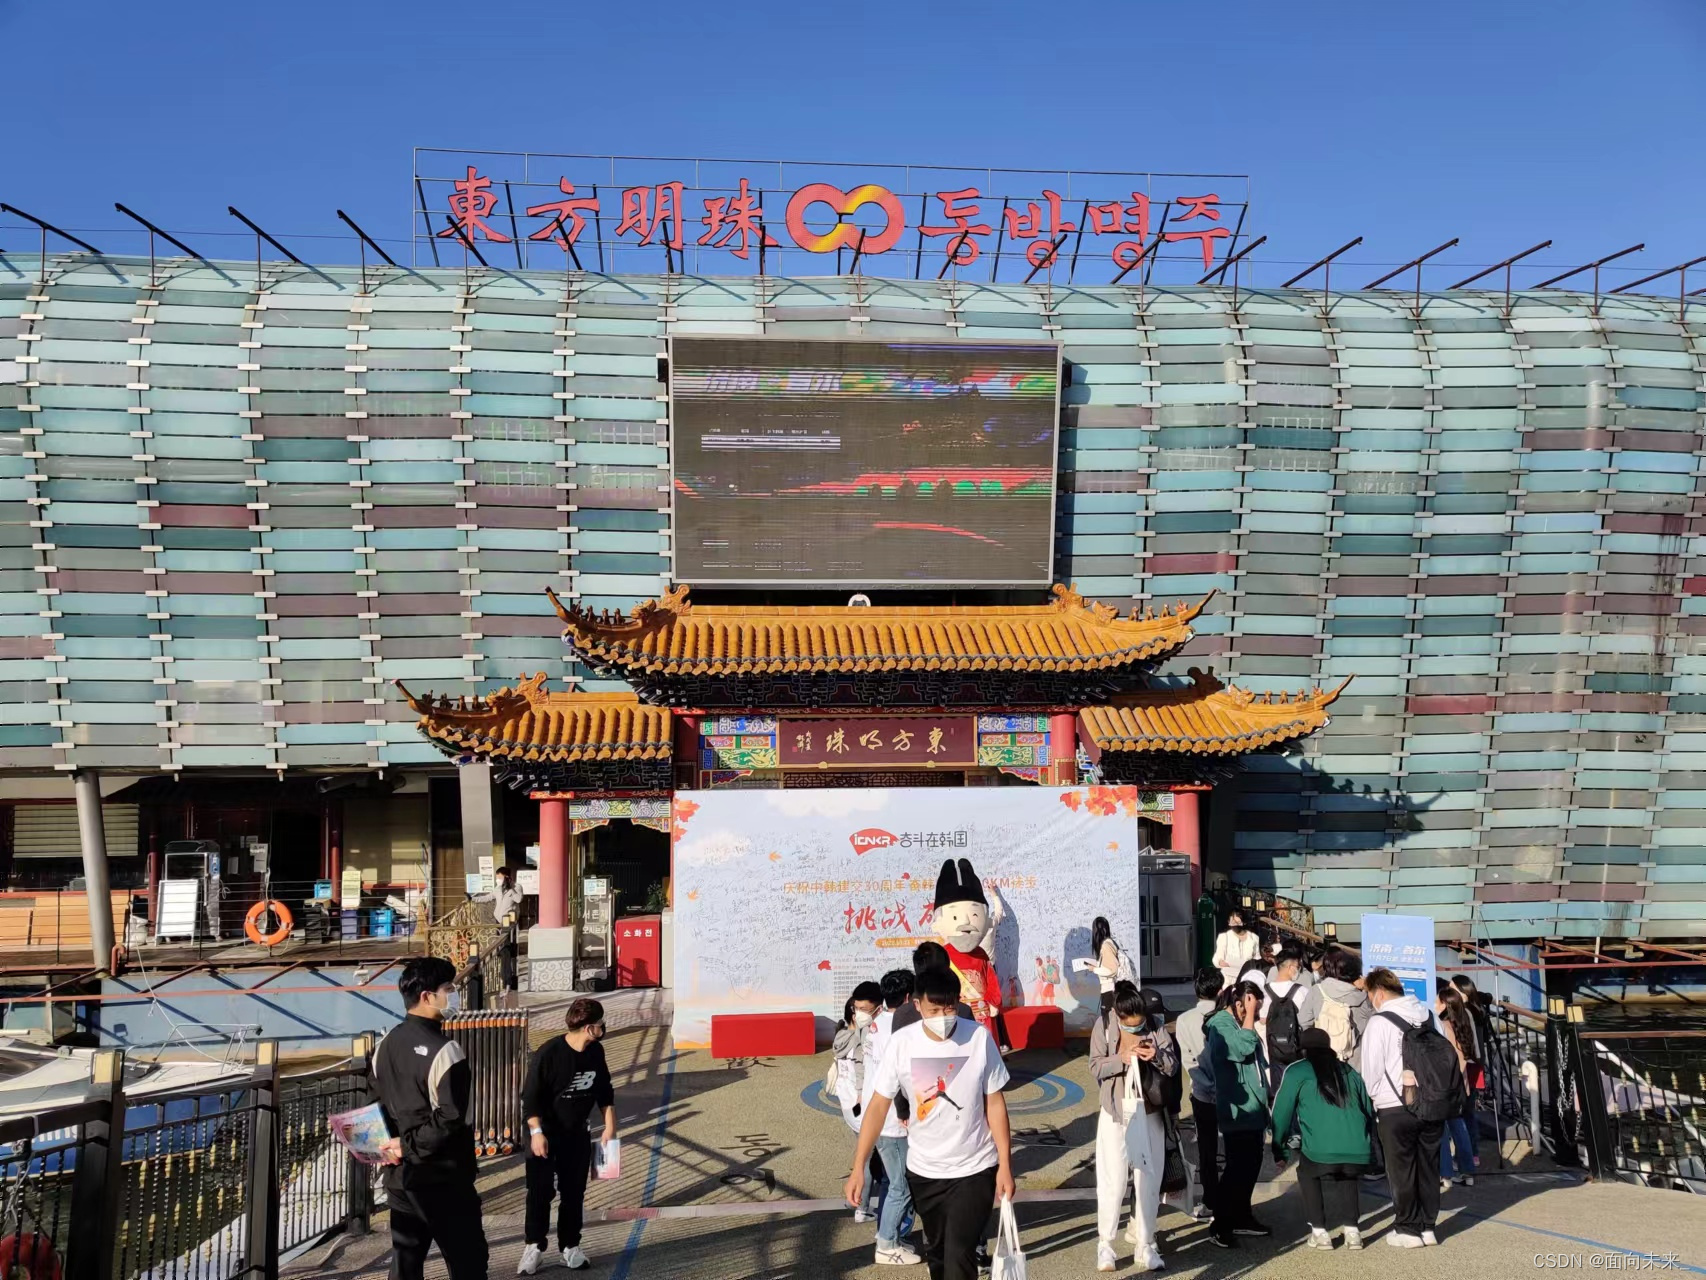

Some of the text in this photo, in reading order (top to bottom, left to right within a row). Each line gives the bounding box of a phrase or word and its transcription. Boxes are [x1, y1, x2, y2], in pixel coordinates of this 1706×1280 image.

[437, 165, 782, 259] 東方明珠
[918, 187, 1231, 272] 동방명주
[900, 831, 968, 848] 奋斗在韩国
